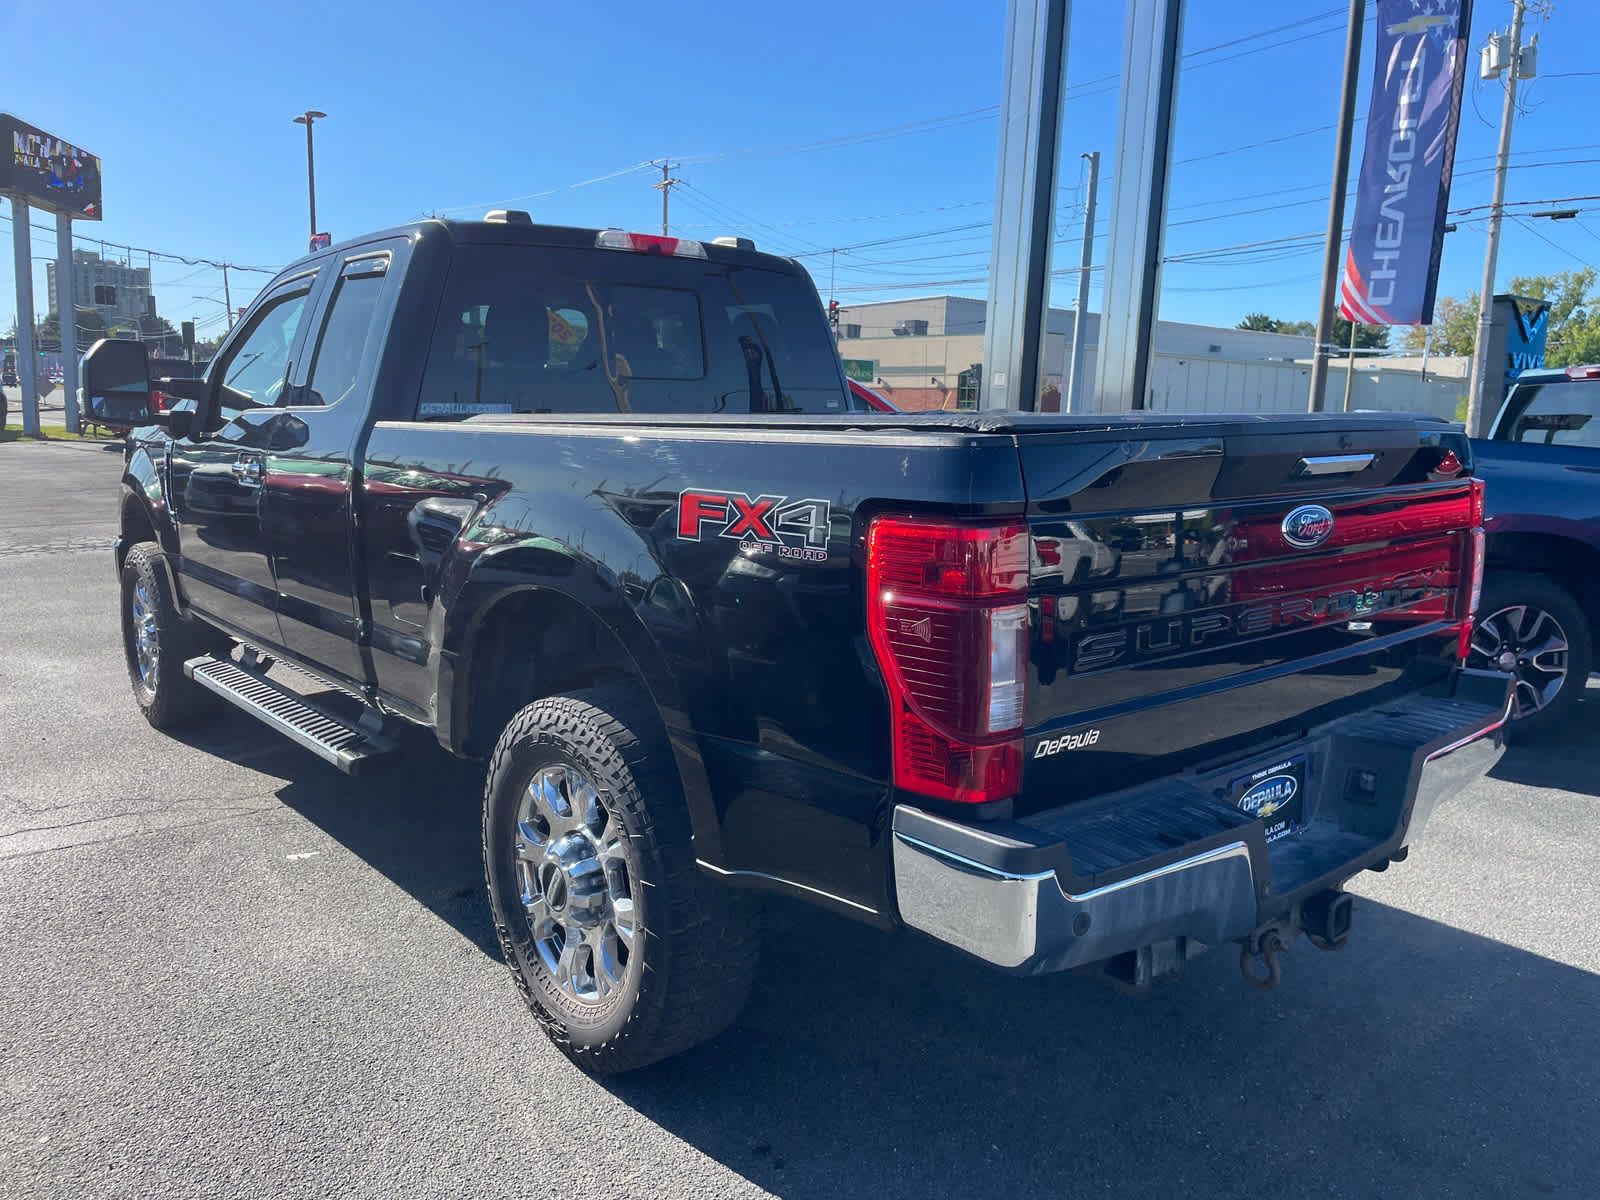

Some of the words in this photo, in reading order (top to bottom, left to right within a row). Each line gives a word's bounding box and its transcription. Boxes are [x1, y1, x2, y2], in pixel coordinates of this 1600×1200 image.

[676, 487, 831, 550] FX4
[1297, 514, 1327, 537] Ford
[738, 540, 773, 553] OFF
[778, 546, 828, 561] ROAD
[1073, 597, 1313, 673] SUPER
[1034, 729, 1100, 758] DePaula
[1243, 781, 1292, 811] DEPAULA
